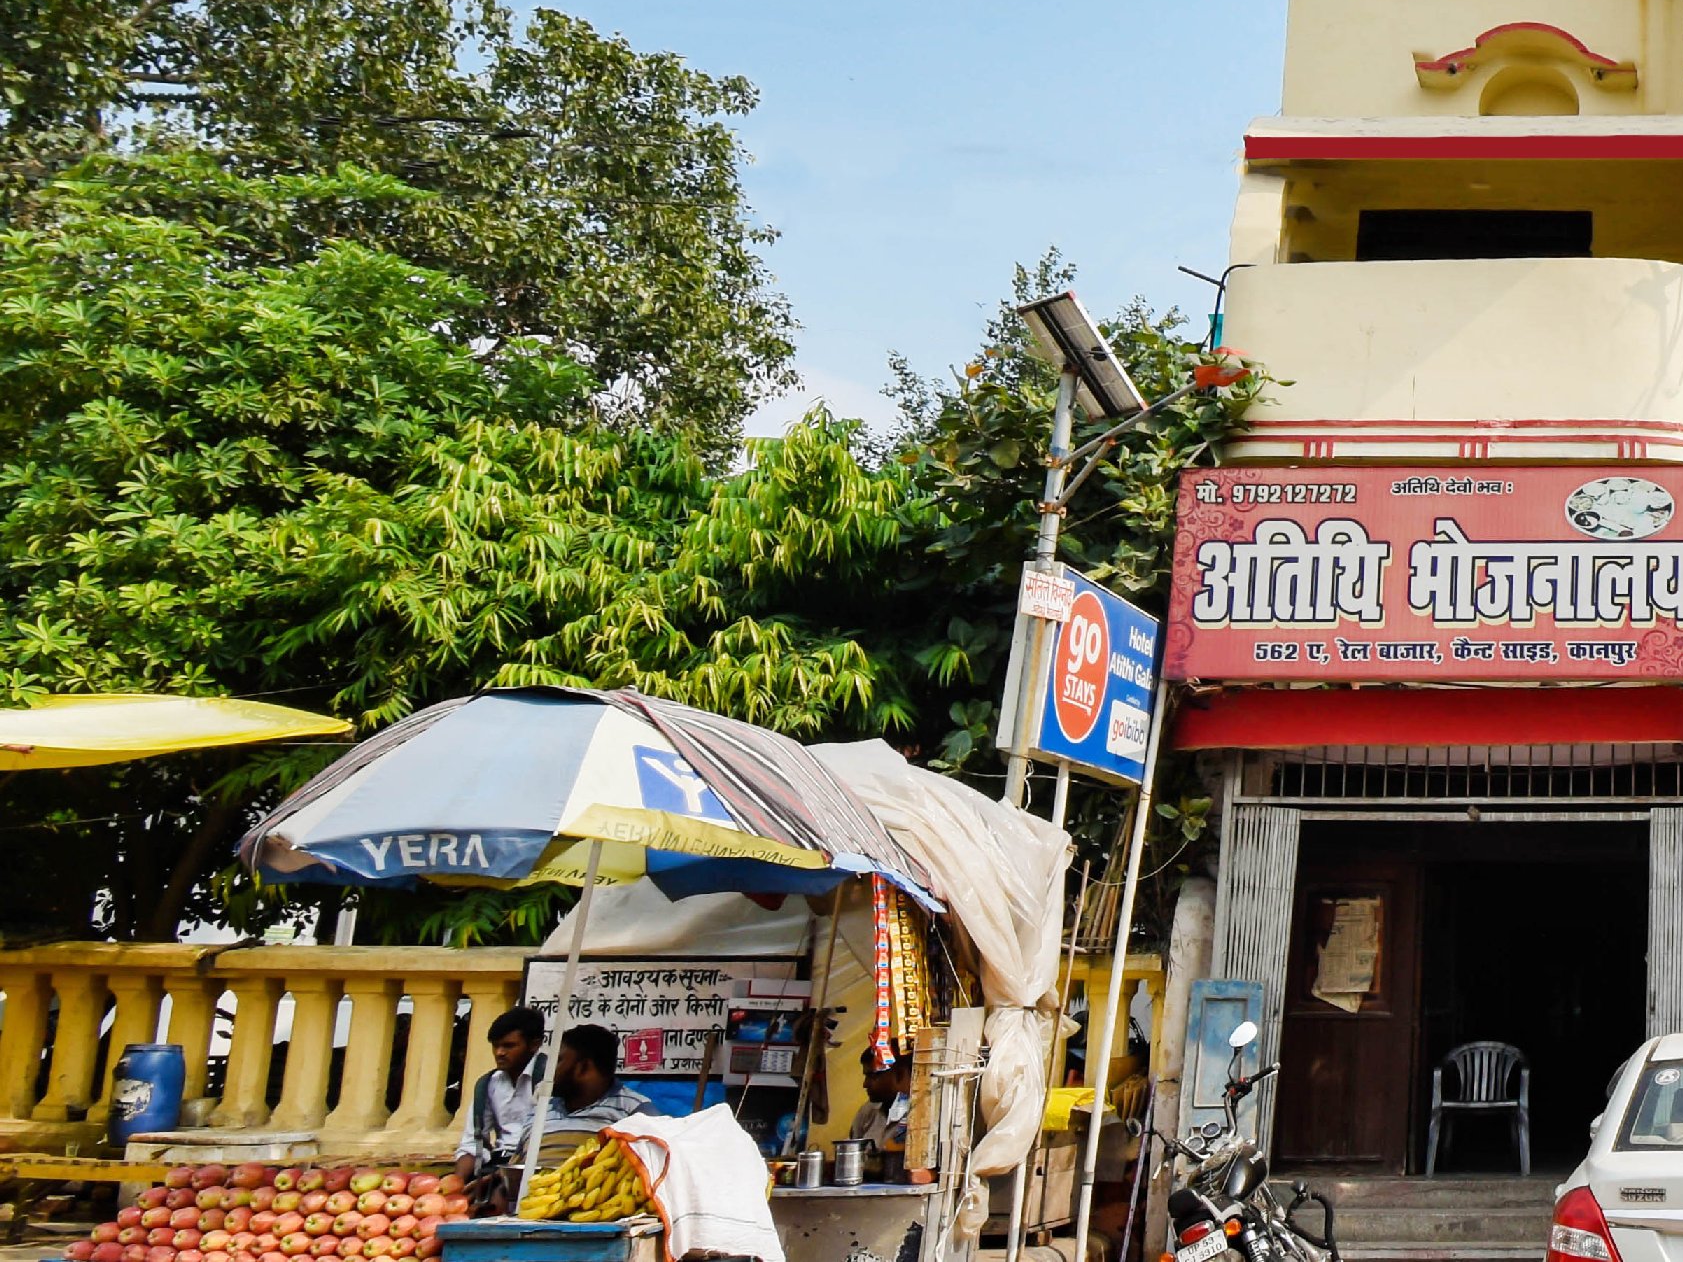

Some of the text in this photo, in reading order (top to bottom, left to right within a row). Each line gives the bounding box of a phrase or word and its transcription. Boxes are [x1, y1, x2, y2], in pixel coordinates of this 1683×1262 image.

[1196, 481, 1356, 504] मो. 9792127272
[1391, 478, 1442, 494] अतिथि
[1444, 478, 1474, 494] देवो
[1193, 517, 1393, 625] अतिथि
[1068, 615, 1101, 673] go
[1129, 626, 1153, 657] Hotel
[1255, 638, 1636, 665] 562 ए, रेल बाजार, कैन्ट साइड, कानपुर
[1109, 652, 1135, 682] Atithi
[1063, 674, 1096, 705] STAYS
[361, 832, 491, 871] YERA
[599, 969, 721, 993] आवश्यक सूचना
[597, 993, 611, 1016] के
